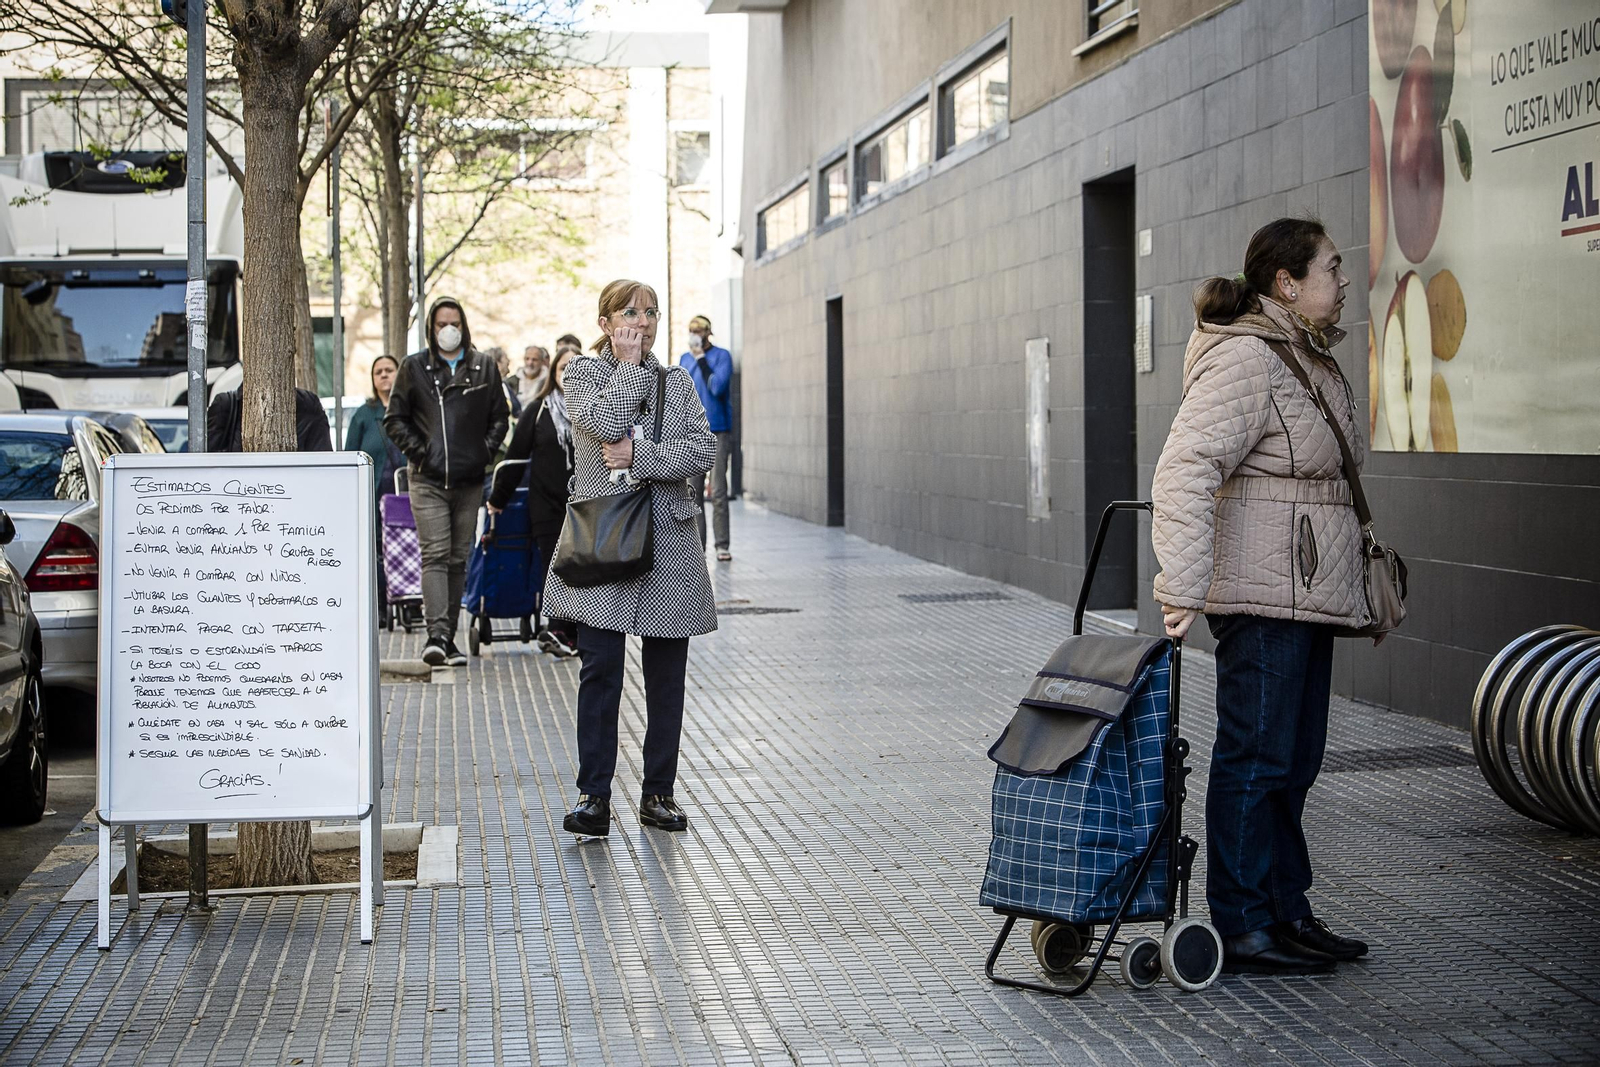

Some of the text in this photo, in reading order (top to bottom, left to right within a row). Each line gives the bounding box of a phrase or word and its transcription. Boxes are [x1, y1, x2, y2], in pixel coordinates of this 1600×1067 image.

[1490, 52, 1507, 86] LO
[1509, 41, 1535, 80] QUE
[1537, 29, 1569, 70] VALE
[1504, 94, 1550, 136] CUESTA
[1553, 82, 1583, 124] MUY
[1561, 161, 1599, 222] AL
[157, 501, 203, 514] PEDIMOS
[211, 502, 229, 513] POR
[172, 525, 179, 535] A
[186, 523, 228, 535] COMPRAR
[251, 518, 270, 533] POR
[210, 541, 258, 554] ANCIANOS
[281, 543, 314, 558] GRUPOS
[320, 548, 334, 557] DE
[149, 564, 177, 578] VENIR
[183, 568, 190, 578] A
[196, 568, 236, 581] COMPRAR
[246, 570, 263, 582] CON
[172, 591, 188, 600] LOS
[197, 590, 241, 603] GUANTES
[134, 605, 144, 615] LA
[197, 622, 233, 634] PAGAR
[242, 622, 264, 635] CON
[280, 641, 322, 653] TAPAROS
[131, 660, 142, 670] LA
[148, 660, 172, 669] BOCA
[180, 660, 200, 670] CON
